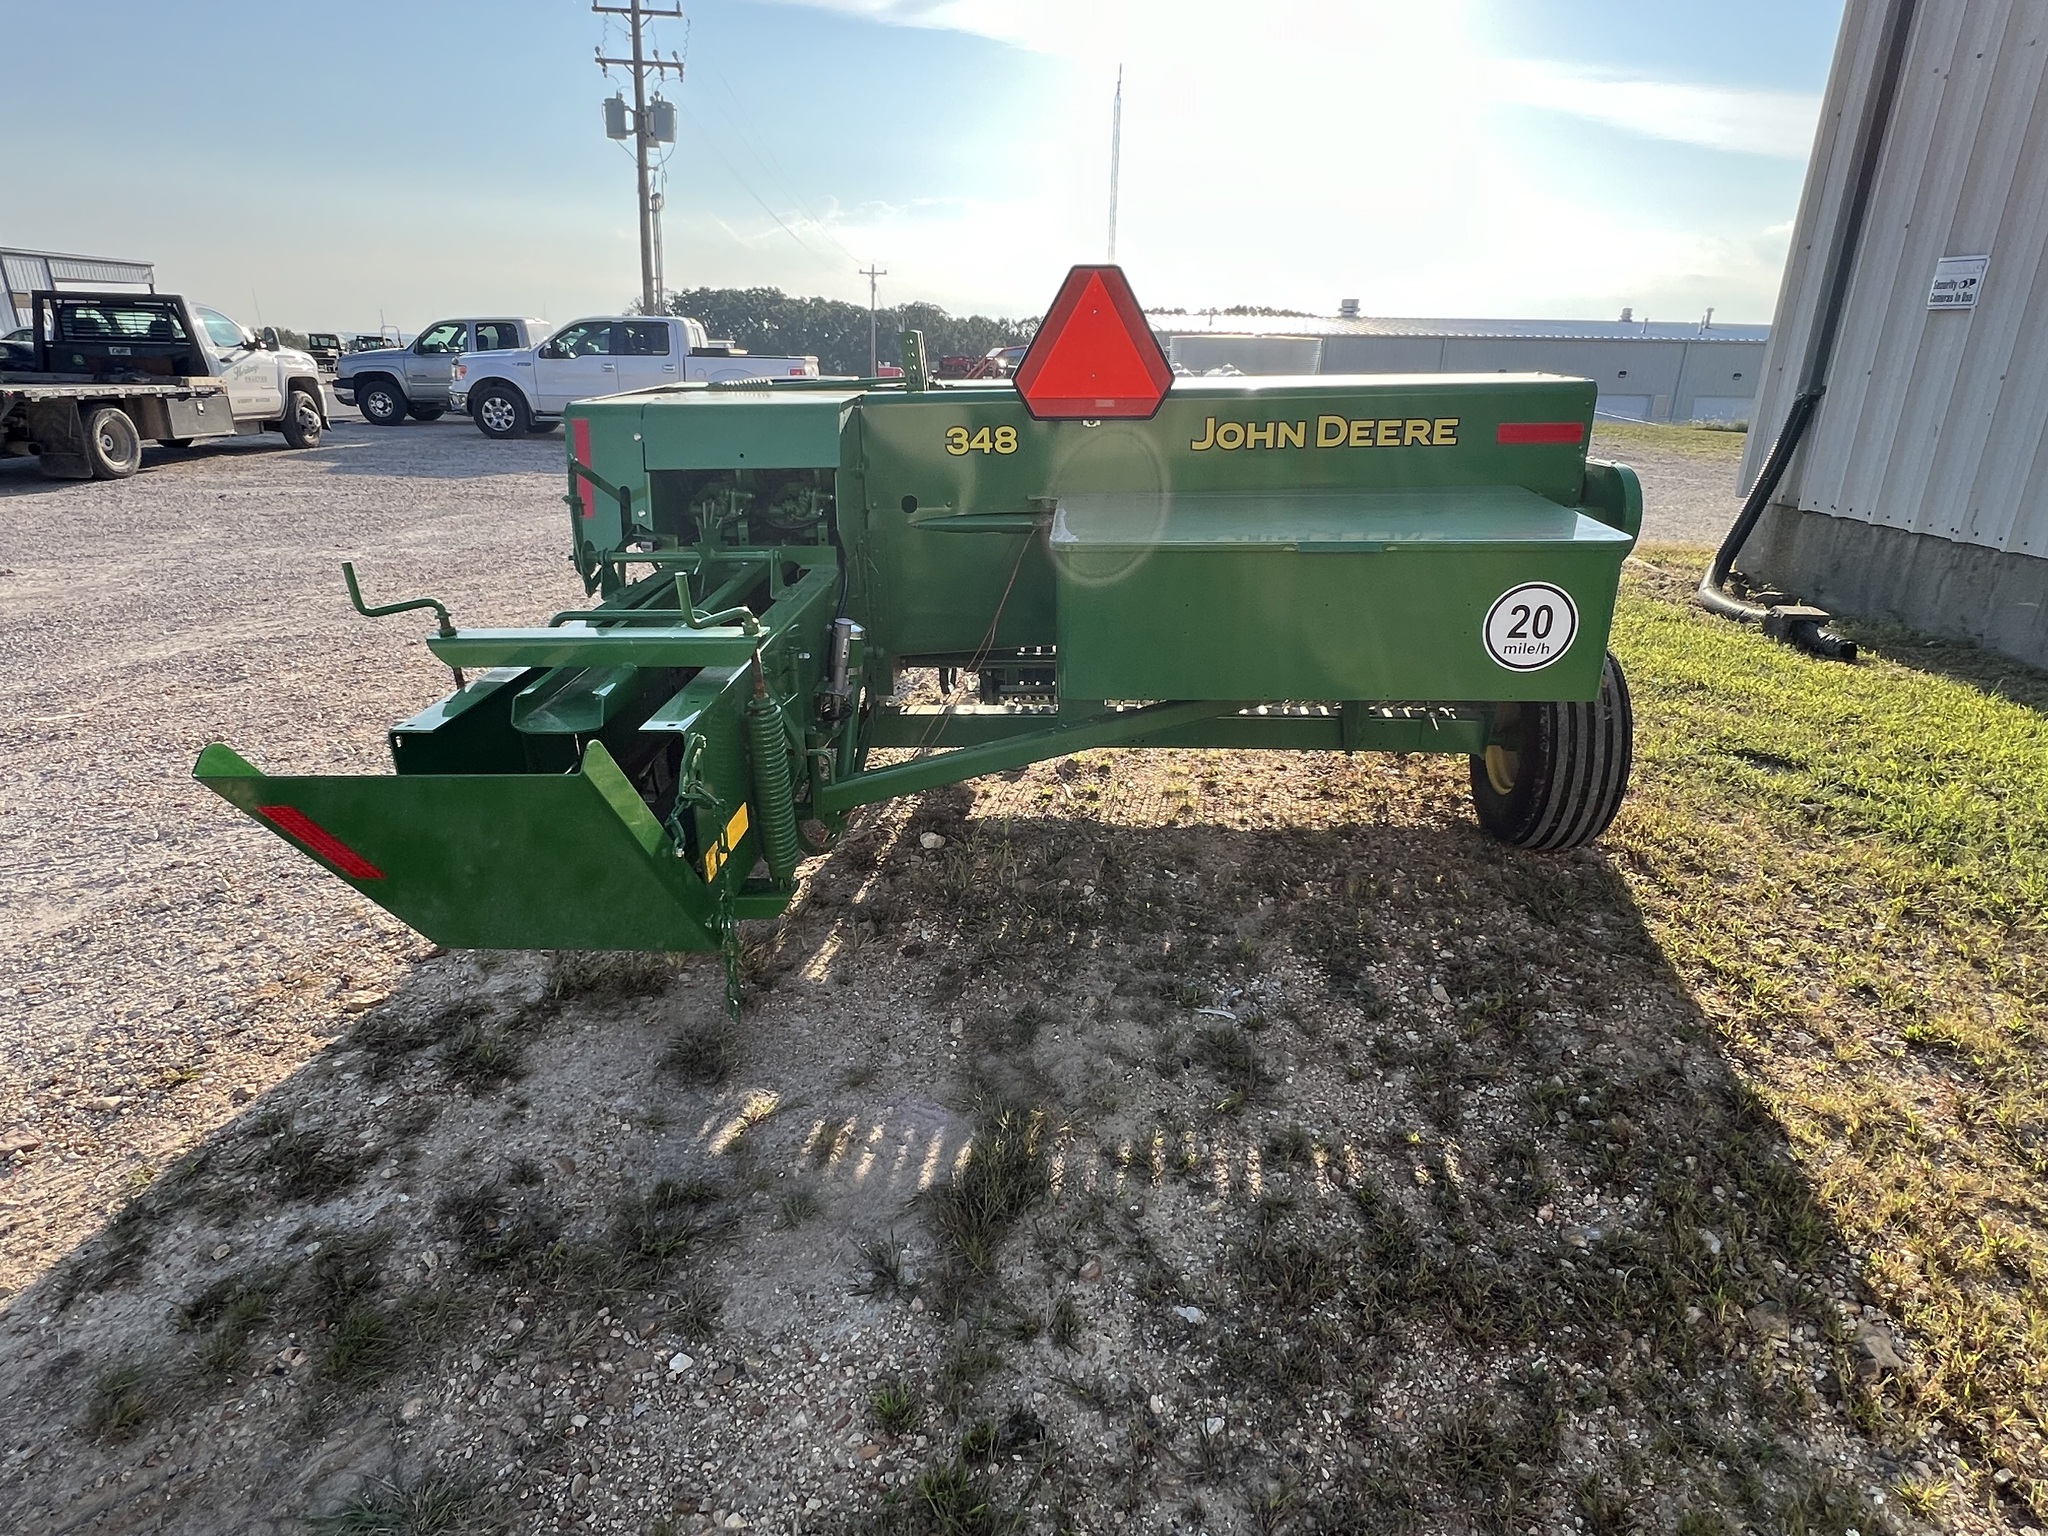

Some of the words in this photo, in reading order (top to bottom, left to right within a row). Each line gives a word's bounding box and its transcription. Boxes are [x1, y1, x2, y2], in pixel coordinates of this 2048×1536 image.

[1933, 279, 1958, 291] Security
[1930, 292, 1954, 303] Cameras
[1961, 291, 1973, 302] Use
[945, 425, 1018, 456] 348
[1191, 416, 1306, 451] JOHN
[1316, 415, 1460, 448] DEERE
[1507, 604, 1553, 639] 20
[1503, 643, 1550, 655] mile/h
